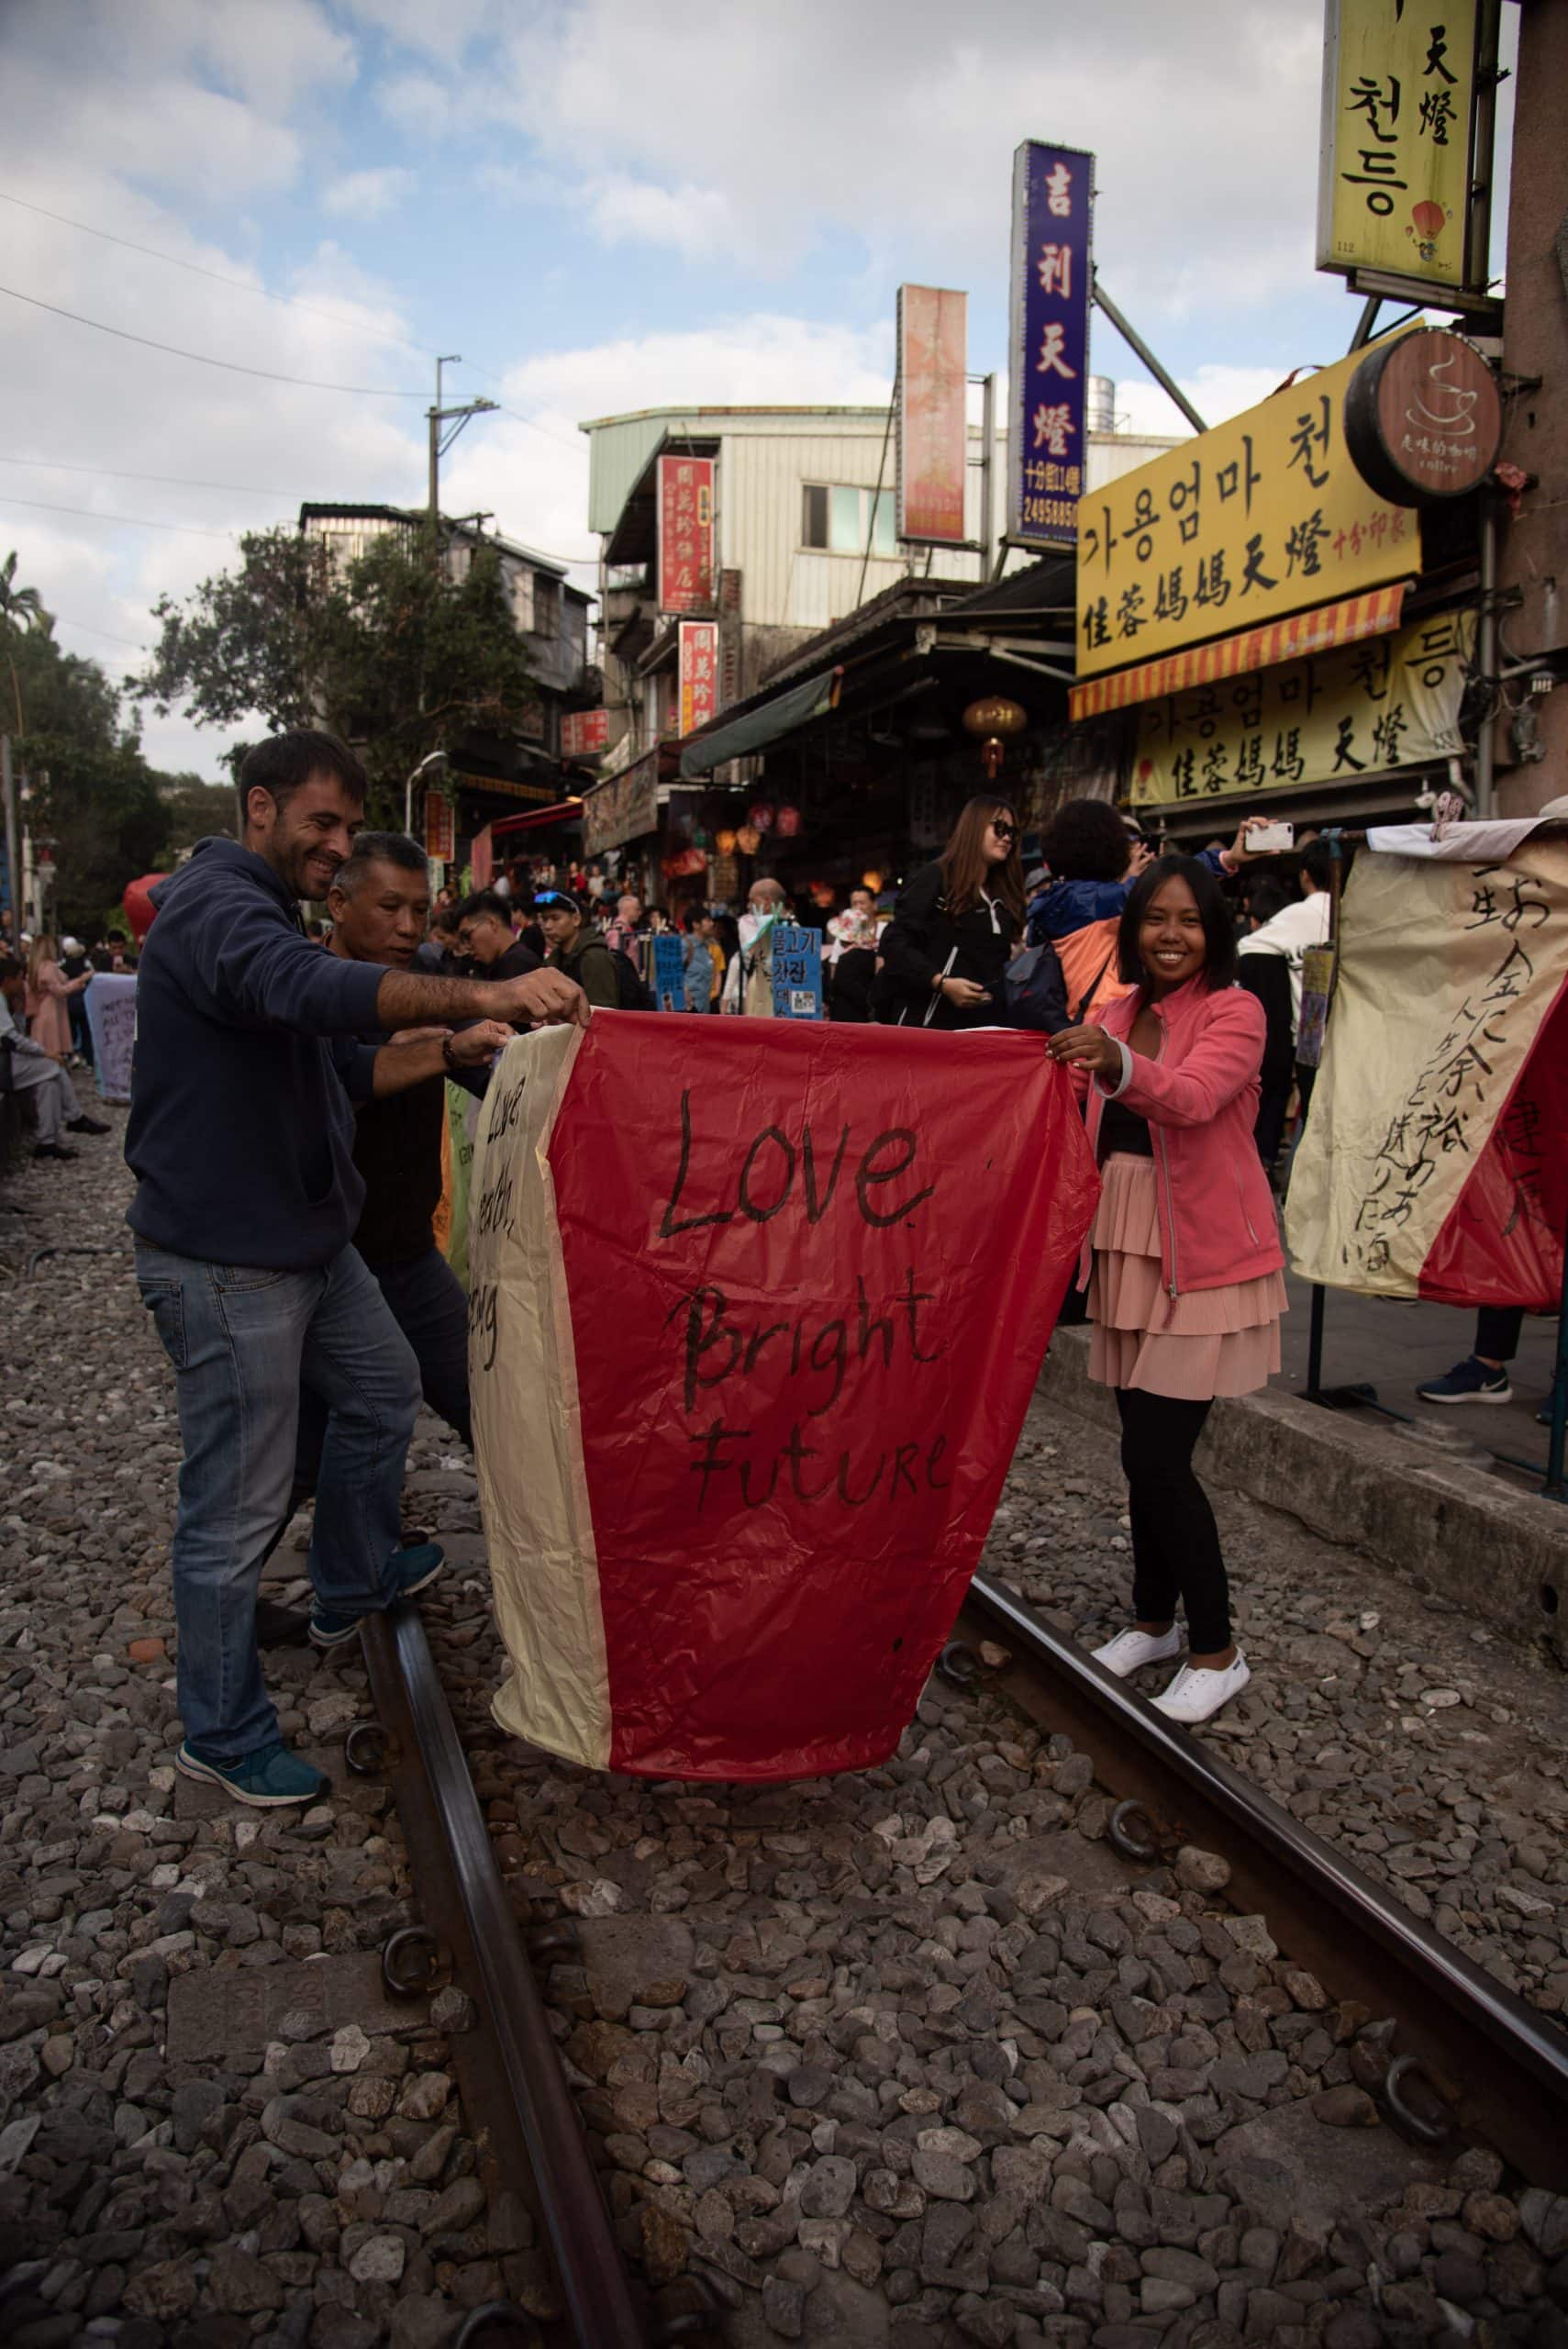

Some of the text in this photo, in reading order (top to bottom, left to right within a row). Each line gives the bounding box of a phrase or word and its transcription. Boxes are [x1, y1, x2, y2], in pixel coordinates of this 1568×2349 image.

[1341, 74, 1408, 217] 천등
[1418, 25, 1459, 146] 天燈
[1033, 161, 1076, 455] 吉利天燈
[1337, 241, 1355, 253] 112
[1083, 395, 1331, 573] 가용엄마 천
[1083, 509, 1331, 650] 佳蓉媽媽天燈
